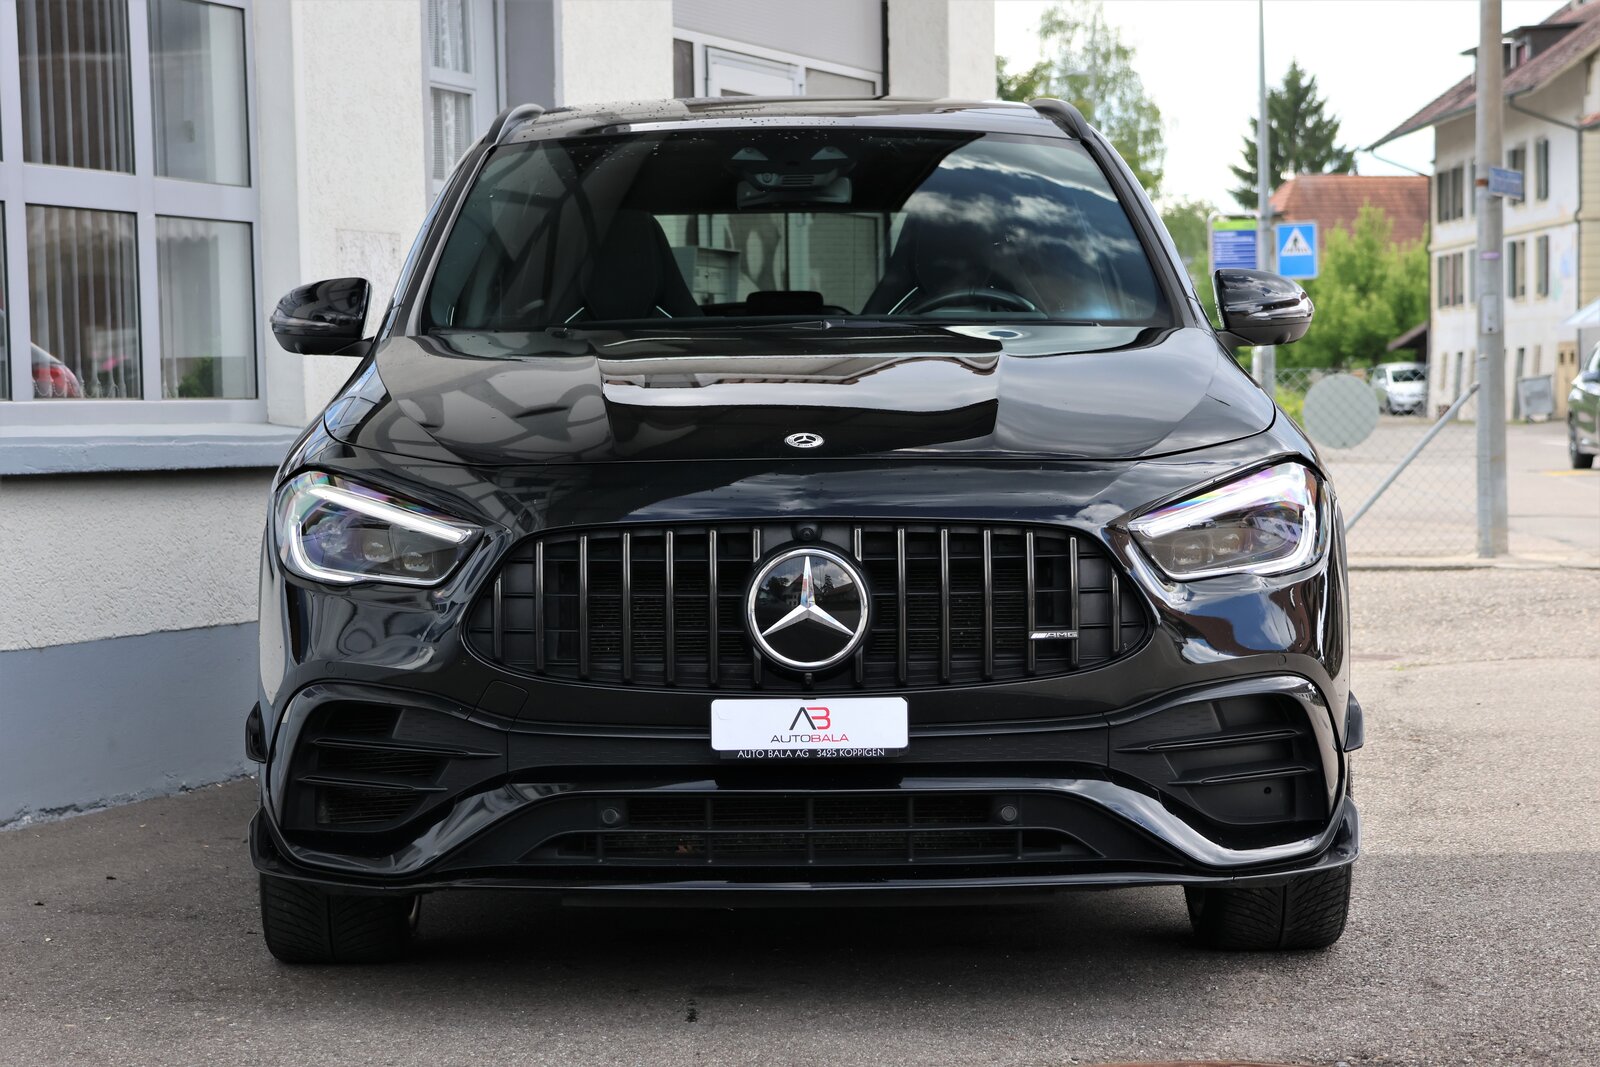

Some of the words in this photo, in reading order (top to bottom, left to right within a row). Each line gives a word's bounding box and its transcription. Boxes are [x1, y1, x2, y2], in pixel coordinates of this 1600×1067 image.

[789, 707, 831, 730] AB
[770, 734, 849, 743] AUTOBALA
[737, 749, 764, 758] AUTO
[768, 749, 793, 758] BALA
[795, 749, 809, 758] AG
[816, 748, 837, 757] 3425
[839, 748, 885, 757] KOPPIGEN
